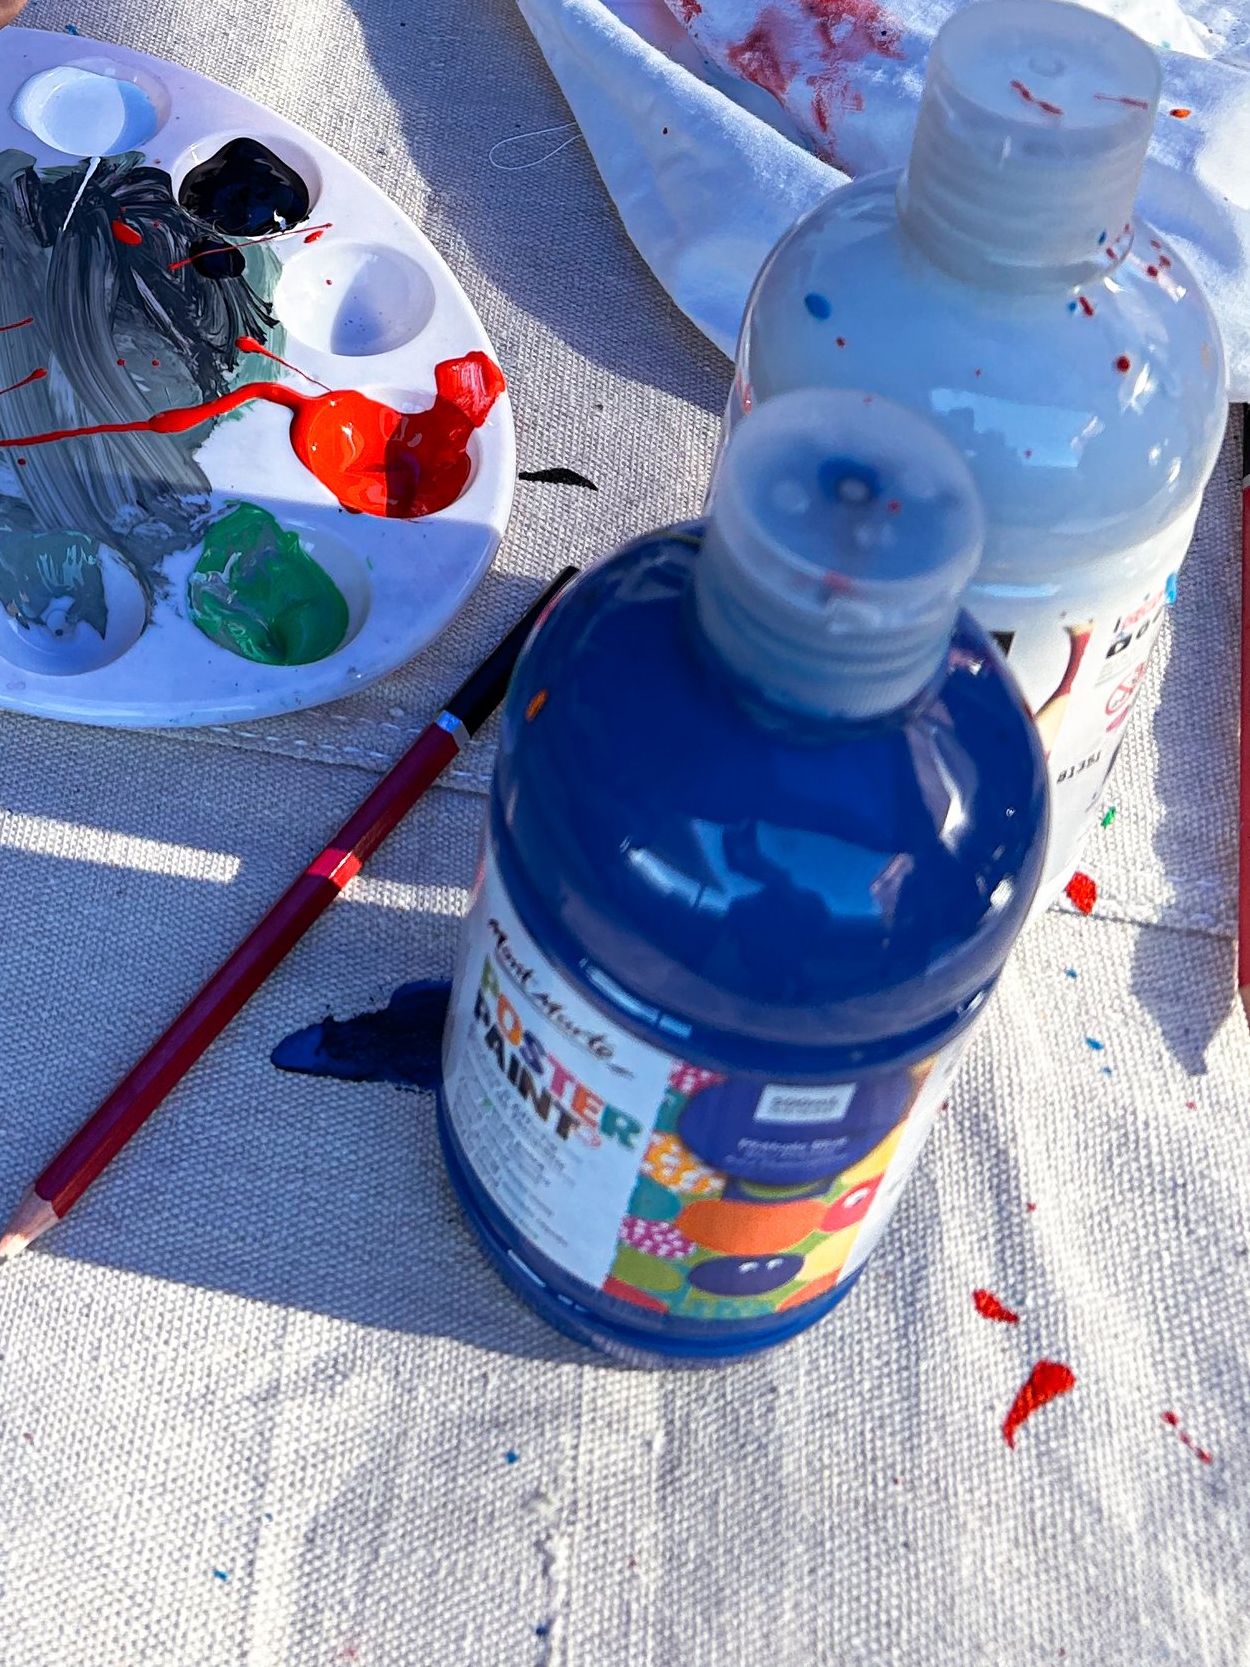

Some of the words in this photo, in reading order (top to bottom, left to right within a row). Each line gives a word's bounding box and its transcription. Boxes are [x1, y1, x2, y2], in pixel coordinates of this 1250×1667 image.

[488, 918, 534, 983] Mont
[474, 988, 580, 1141] PAINT
[481, 954, 646, 1150] POSTER
